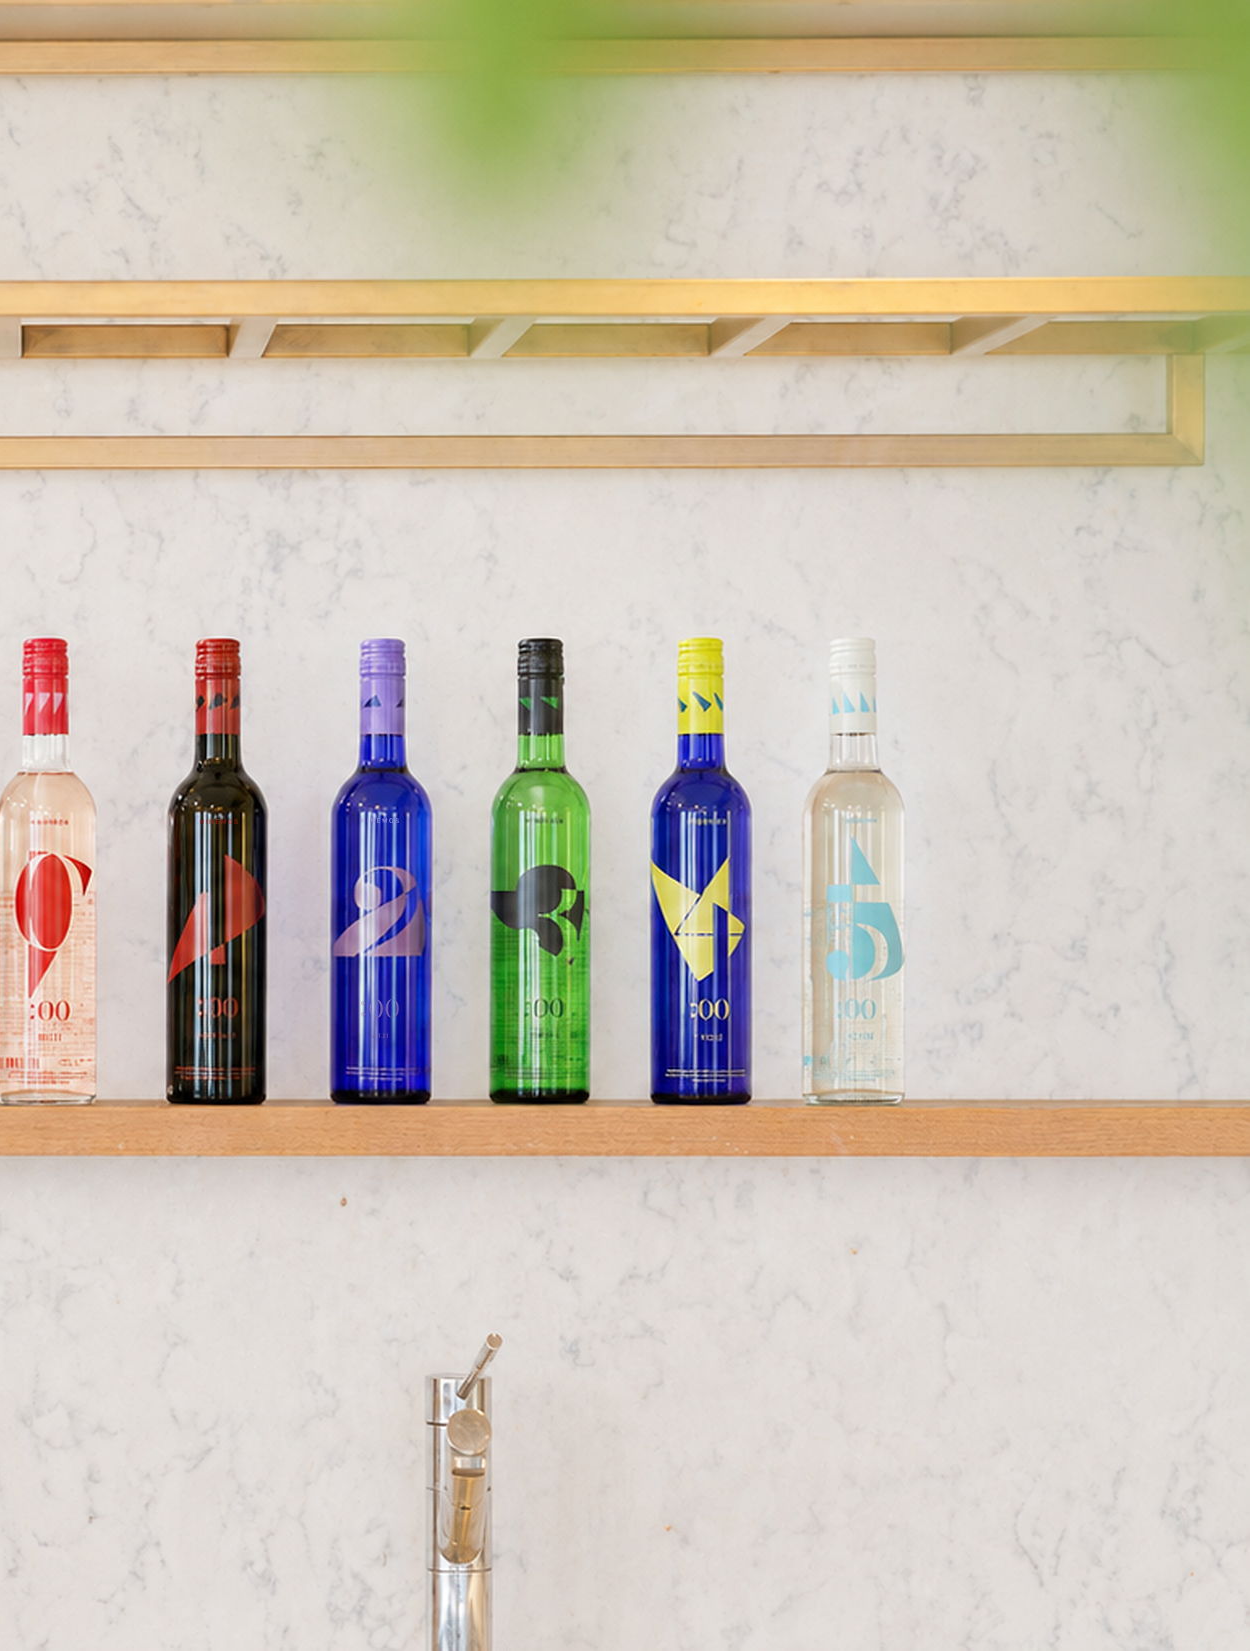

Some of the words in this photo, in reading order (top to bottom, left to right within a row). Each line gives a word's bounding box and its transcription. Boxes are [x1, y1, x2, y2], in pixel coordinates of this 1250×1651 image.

[333, 866, 426, 958] 2
[826, 838, 905, 981] 5
[29, 999, 70, 1022] :00
